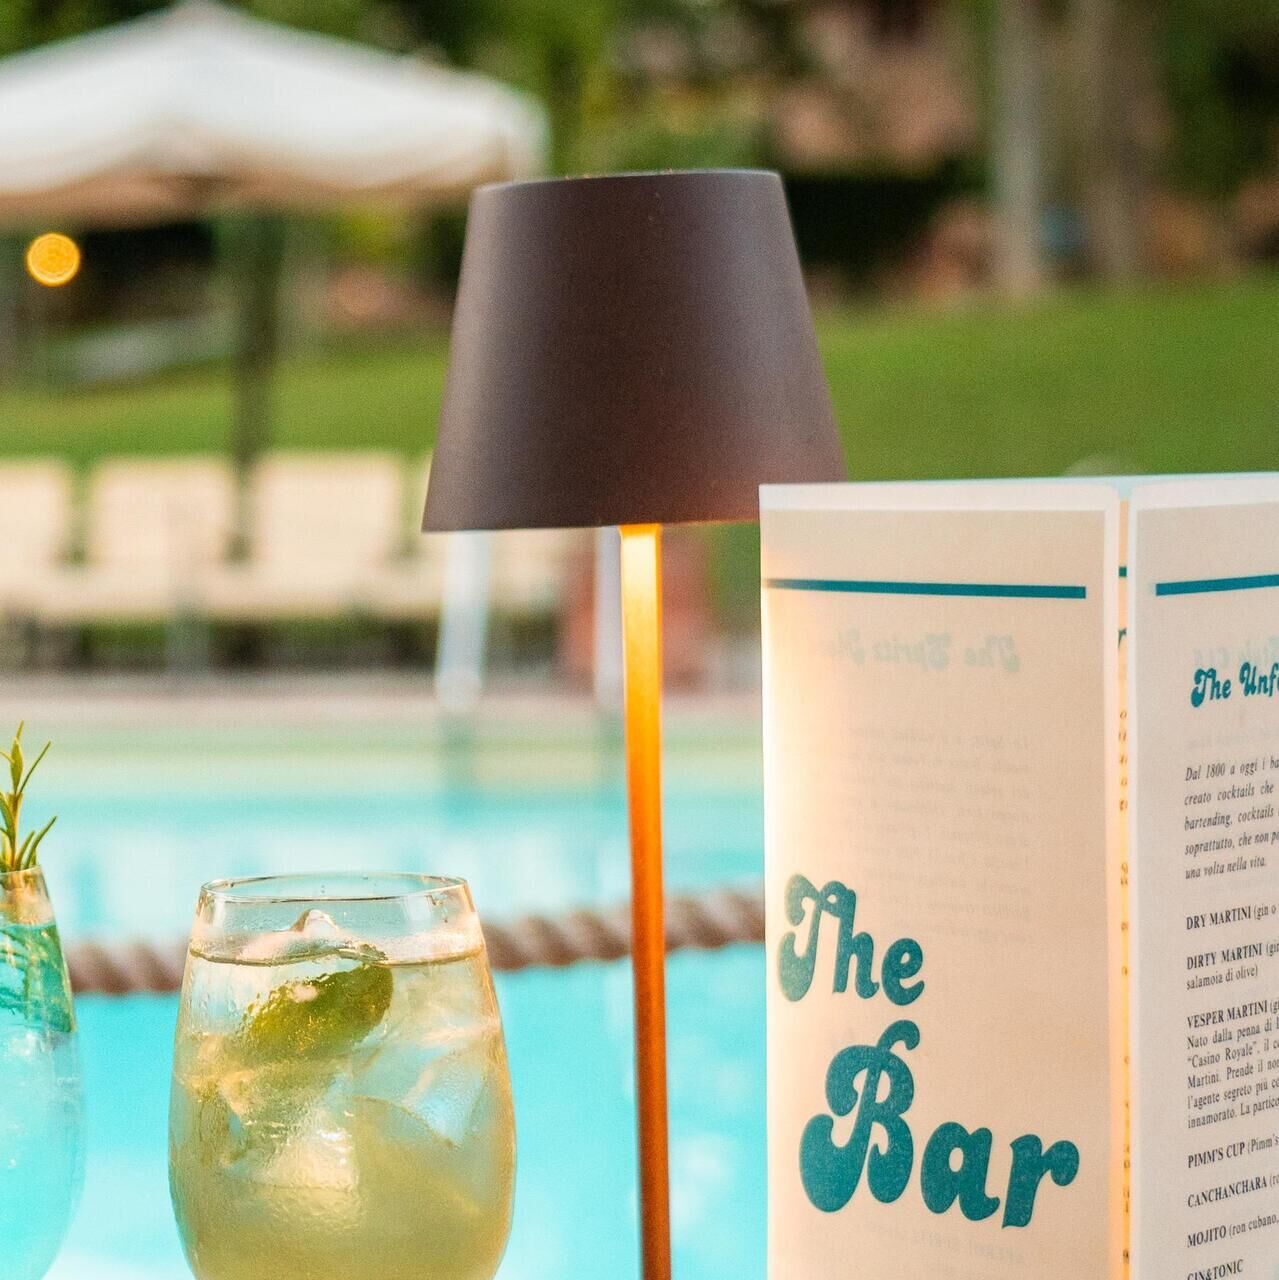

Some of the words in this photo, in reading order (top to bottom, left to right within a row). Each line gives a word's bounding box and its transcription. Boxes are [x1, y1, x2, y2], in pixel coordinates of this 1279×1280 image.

[1191, 668, 1231, 707] The
[1186, 765, 1201, 781] Dal
[1206, 763, 1225, 779] 1800
[1230, 765, 1235, 775] a
[1240, 759, 1258, 776] oggi
[1184, 793, 1211, 806] creato
[1217, 783, 1255, 801] cocktails
[1260, 780, 1274, 795] che
[1184, 812, 1233, 831] bartending,
[1238, 804, 1274, 823] cocktails
[1184, 838, 1234, 857] soprattutto,
[1238, 832, 1252, 847] che
[1255, 832, 1269, 844] non
[1185, 869, 1201, 880] una
[1204, 861, 1224, 876] volta
[1227, 856, 1247, 872] nella
[1250, 855, 1266, 868] vita.
[1186, 914, 1207, 930] DRY
[1209, 905, 1251, 926] MARTINI
[1253, 903, 1269, 920] (gin
[1271, 905, 1276, 914] o
[777, 873, 925, 1005] The
[1187, 952, 1217, 970] DIRTY
[1221, 943, 1262, 963] MARTINI
[1186, 971, 1223, 990] salamoia
[1225, 968, 1233, 982] di
[1236, 964, 1258, 980] olive)
[1187, 1010, 1224, 1028] VESPER
[1227, 1000, 1267, 1021] MARTINI
[1187, 1036, 1208, 1049] Nato
[1212, 1028, 1233, 1043] dalla
[1237, 1024, 1260, 1042] penna
[1264, 1018, 1272, 1032] di
[1264, 1038, 1270, 1052] il
[1226, 1062, 1254, 1080] Prende
[1258, 1059, 1263, 1072] il
[1188, 1093, 1220, 1110] l'agente
[1224, 1084, 1252, 1101] segreto
[1255, 1079, 1268, 1096] più
[799, 1020, 1080, 1229] Bar
[1188, 1108, 1237, 1129] innamorato.
[1240, 1103, 1250, 1116] La
[1188, 1147, 1224, 1168] PIMM'S
[1226, 1142, 1245, 1158] CUP
[1187, 1176, 1267, 1208] CANCHANCHARA
[1187, 1225, 1227, 1248] MOJITO
[1229, 1223, 1246, 1239] (ron
